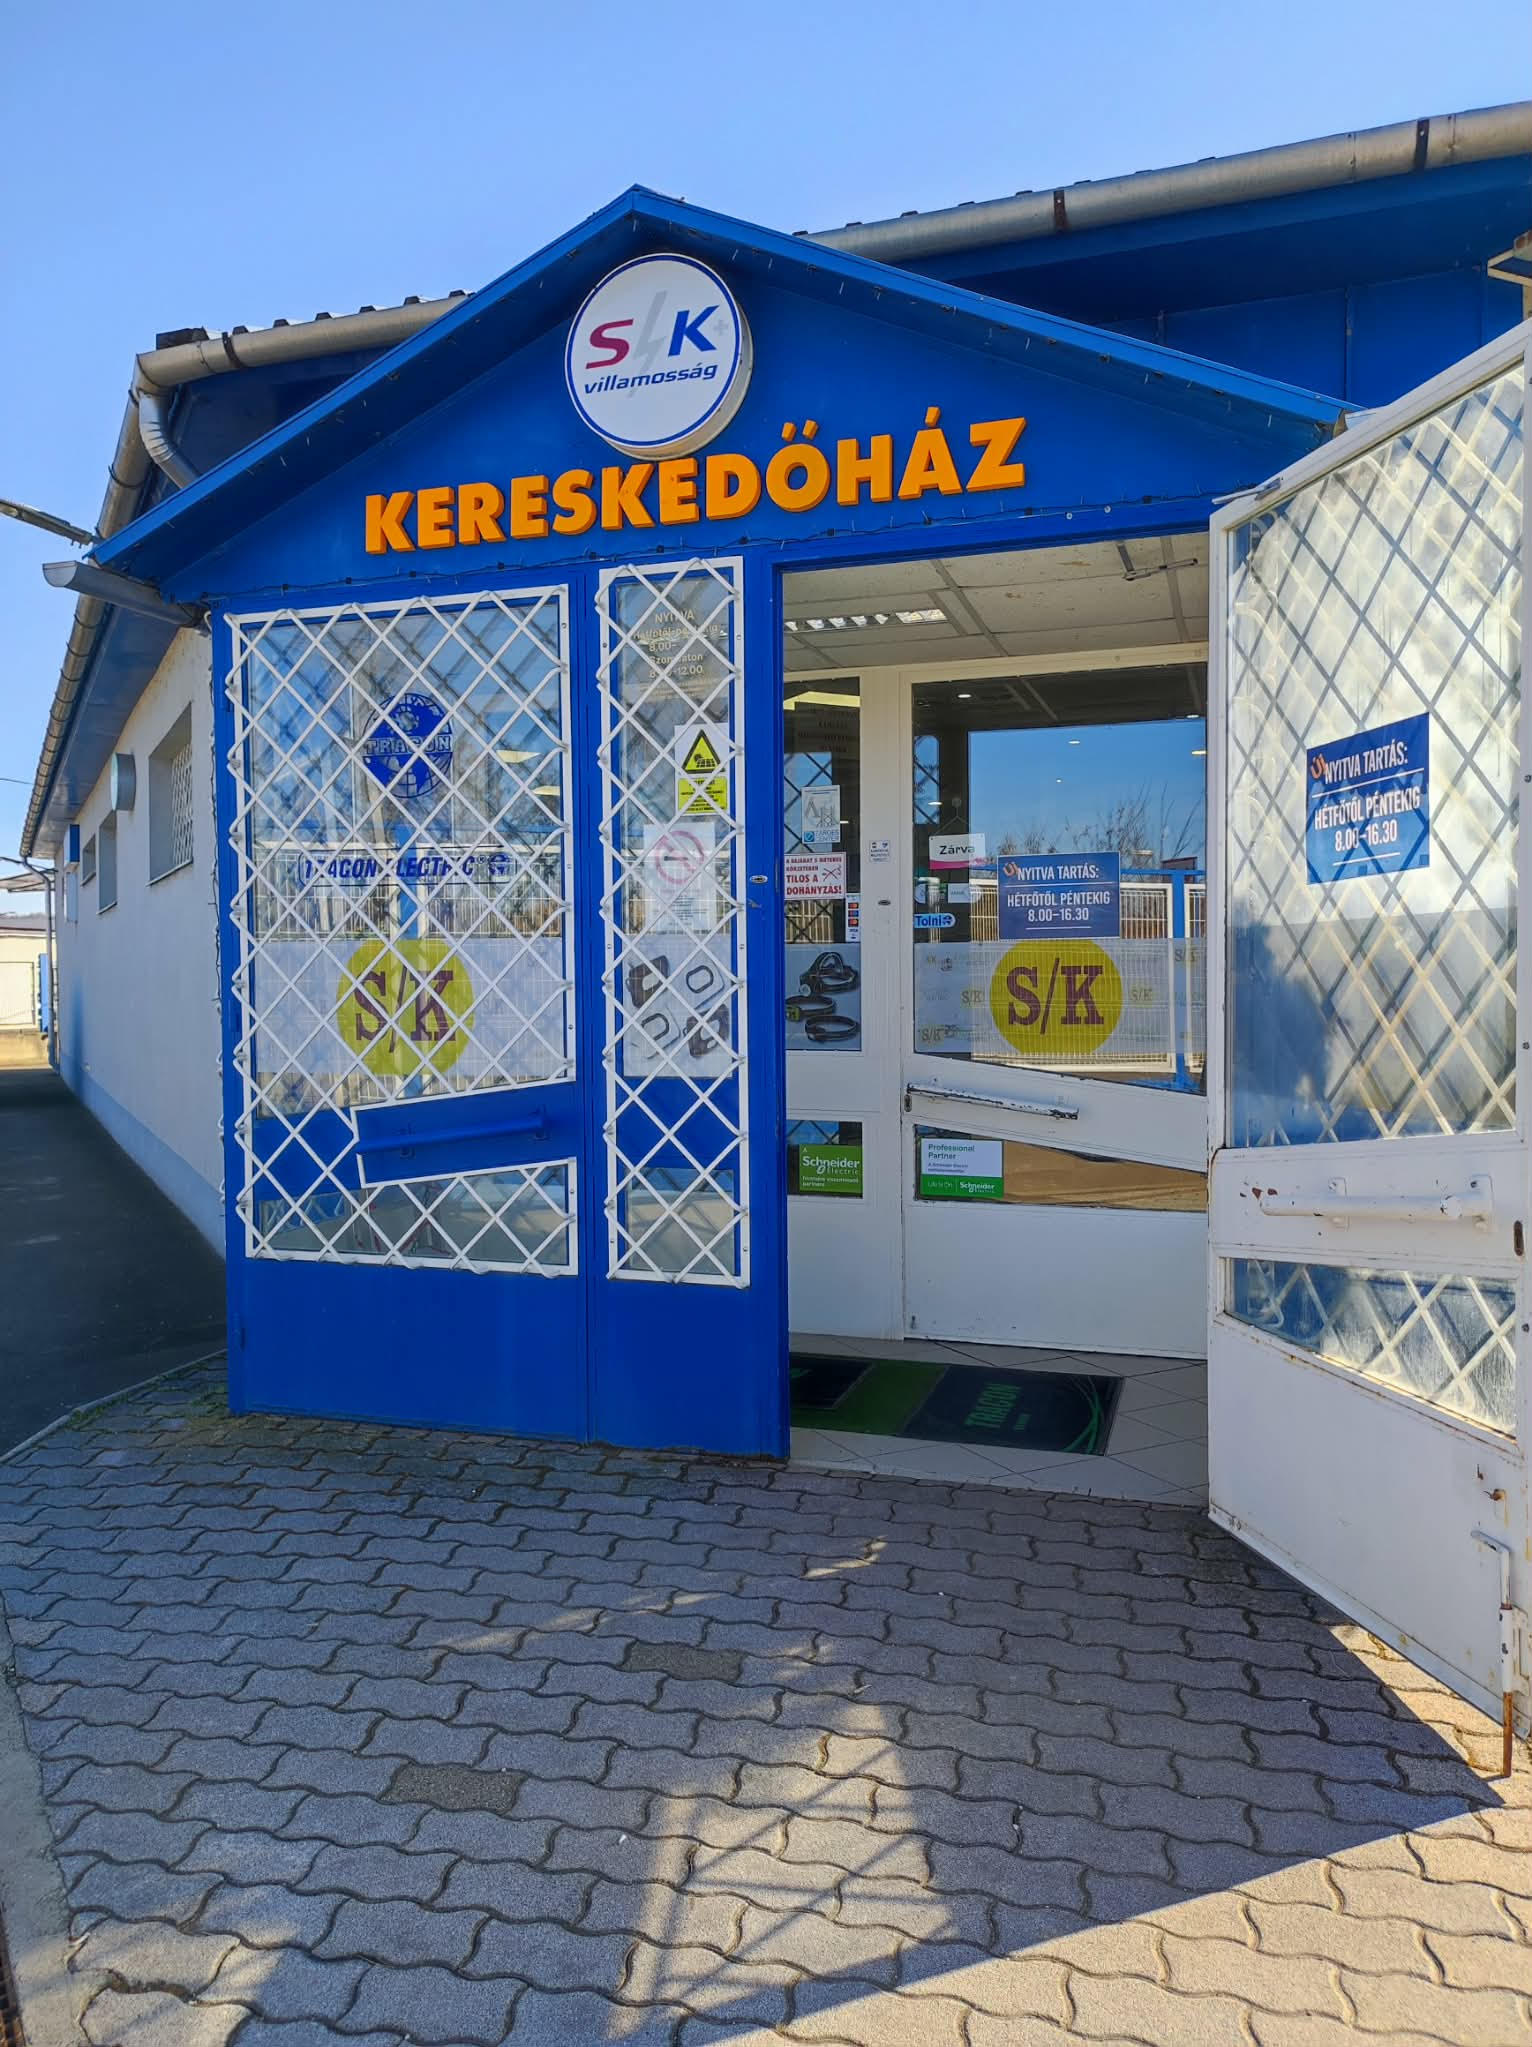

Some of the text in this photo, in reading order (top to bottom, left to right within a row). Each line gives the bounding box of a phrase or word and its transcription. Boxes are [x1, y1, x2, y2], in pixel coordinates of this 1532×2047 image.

[584, 362, 718, 394] villamosság
[365, 406, 1028, 555] KERESKEDŐHÁZ
[1325, 754, 1361, 785] NYITVA
[1362, 739, 1408, 774] TARTÁS:
[1365, 786, 1420, 819] PÉNTEKIG
[939, 844, 975, 855] Zárva
[786, 874, 819, 884] TILOS A
[1017, 866, 1055, 881] NYITVA
[1057, 862, 1100, 880] TARTÁS:
[786, 883, 842, 896] DOHÁNYZÁS!
[1008, 890, 1111, 908] HÉTFŐTŐL PÉNTEKIG
[914, 915, 942, 927] Tolni
[1006, 957, 1105, 1035] S/K
[928, 1143, 975, 1152] Professional
[802, 1155, 860, 1169] Schneider
[928, 1152, 956, 1160] Partner
